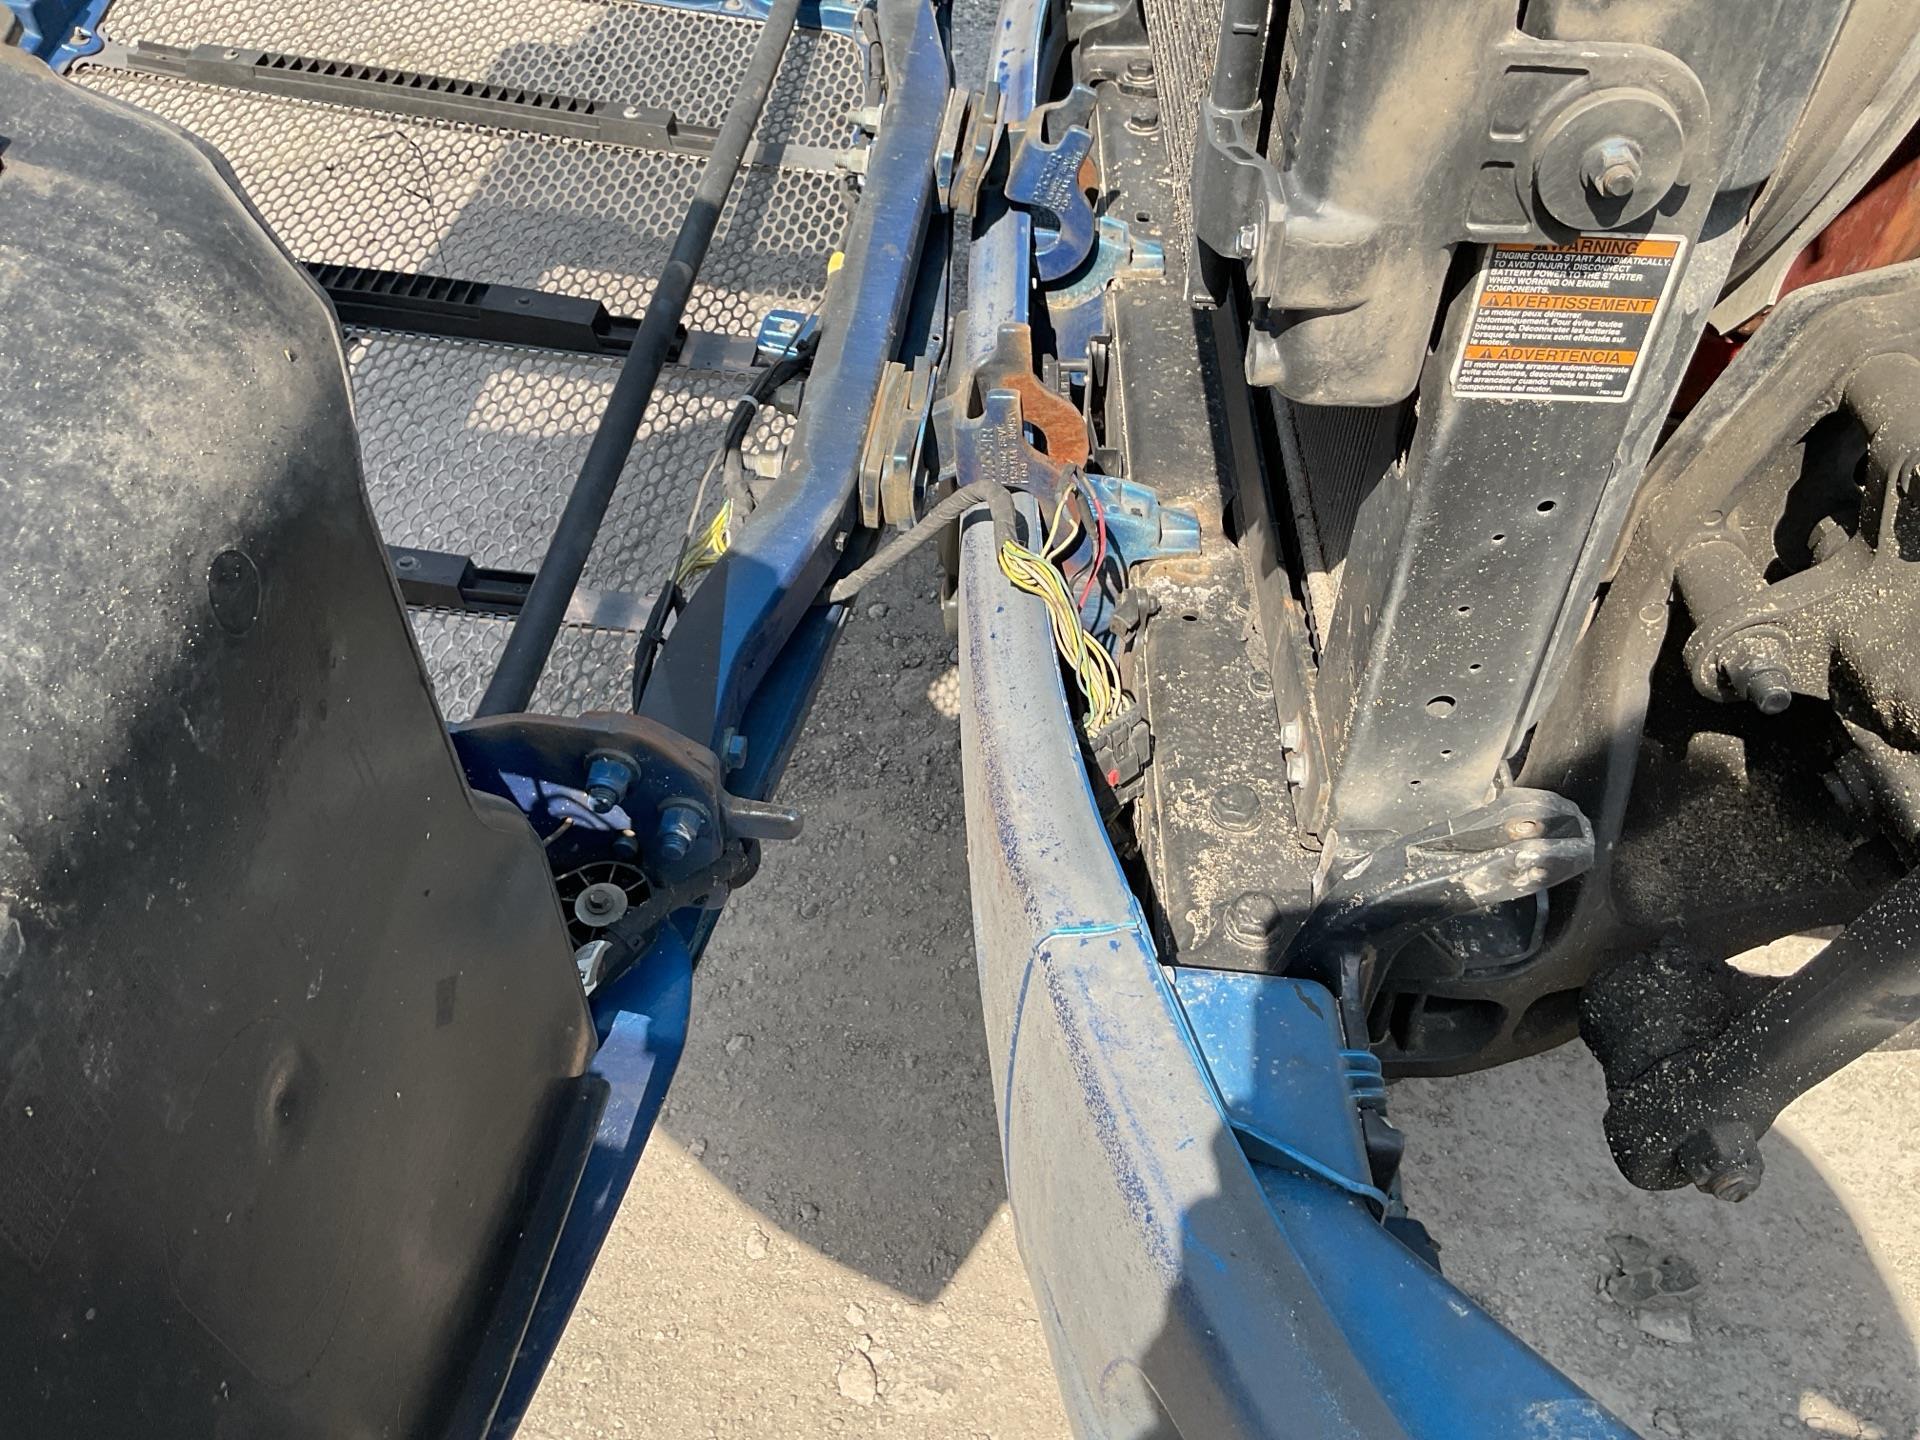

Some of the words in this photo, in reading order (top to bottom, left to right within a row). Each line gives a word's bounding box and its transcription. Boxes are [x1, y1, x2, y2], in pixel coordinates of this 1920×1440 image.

[1496, 252, 1529, 260] ENGINE
[1531, 253, 1562, 261] COULD
[1564, 254, 1593, 262] START
[1595, 256, 1671, 266] AUTOMATICALLY.
[1508, 261, 1535, 269] AVOID
[1573, 264, 1631, 272] DISCONNECT
[1491, 268, 1532, 277] BATTERY
[1534, 270, 1566, 278] POWER
[1584, 272, 1600, 280] THE
[1602, 273, 1644, 281] STARTER
[1518, 278, 1559, 286] WORKING
[1561, 279, 1575, 287] ON
[1576, 280, 1611, 288] ENGINE
[1486, 285, 1550, 294] COMPONENTS.
[1501, 295, 1651, 312] AVERTISSEMENT
[1519, 325, 1569, 333] Déconnecter
[1472, 331, 1503, 339] lorsque
[1498, 348, 1620, 363] ADVERTENCIA
[1499, 362, 1524, 370] puede
[1530, 370, 1575, 379] desconecte
[1457, 383, 1511, 391] componentes
[1473, 376, 1517, 384] arrancador
[1550, 379, 1577, 388] trabaje
